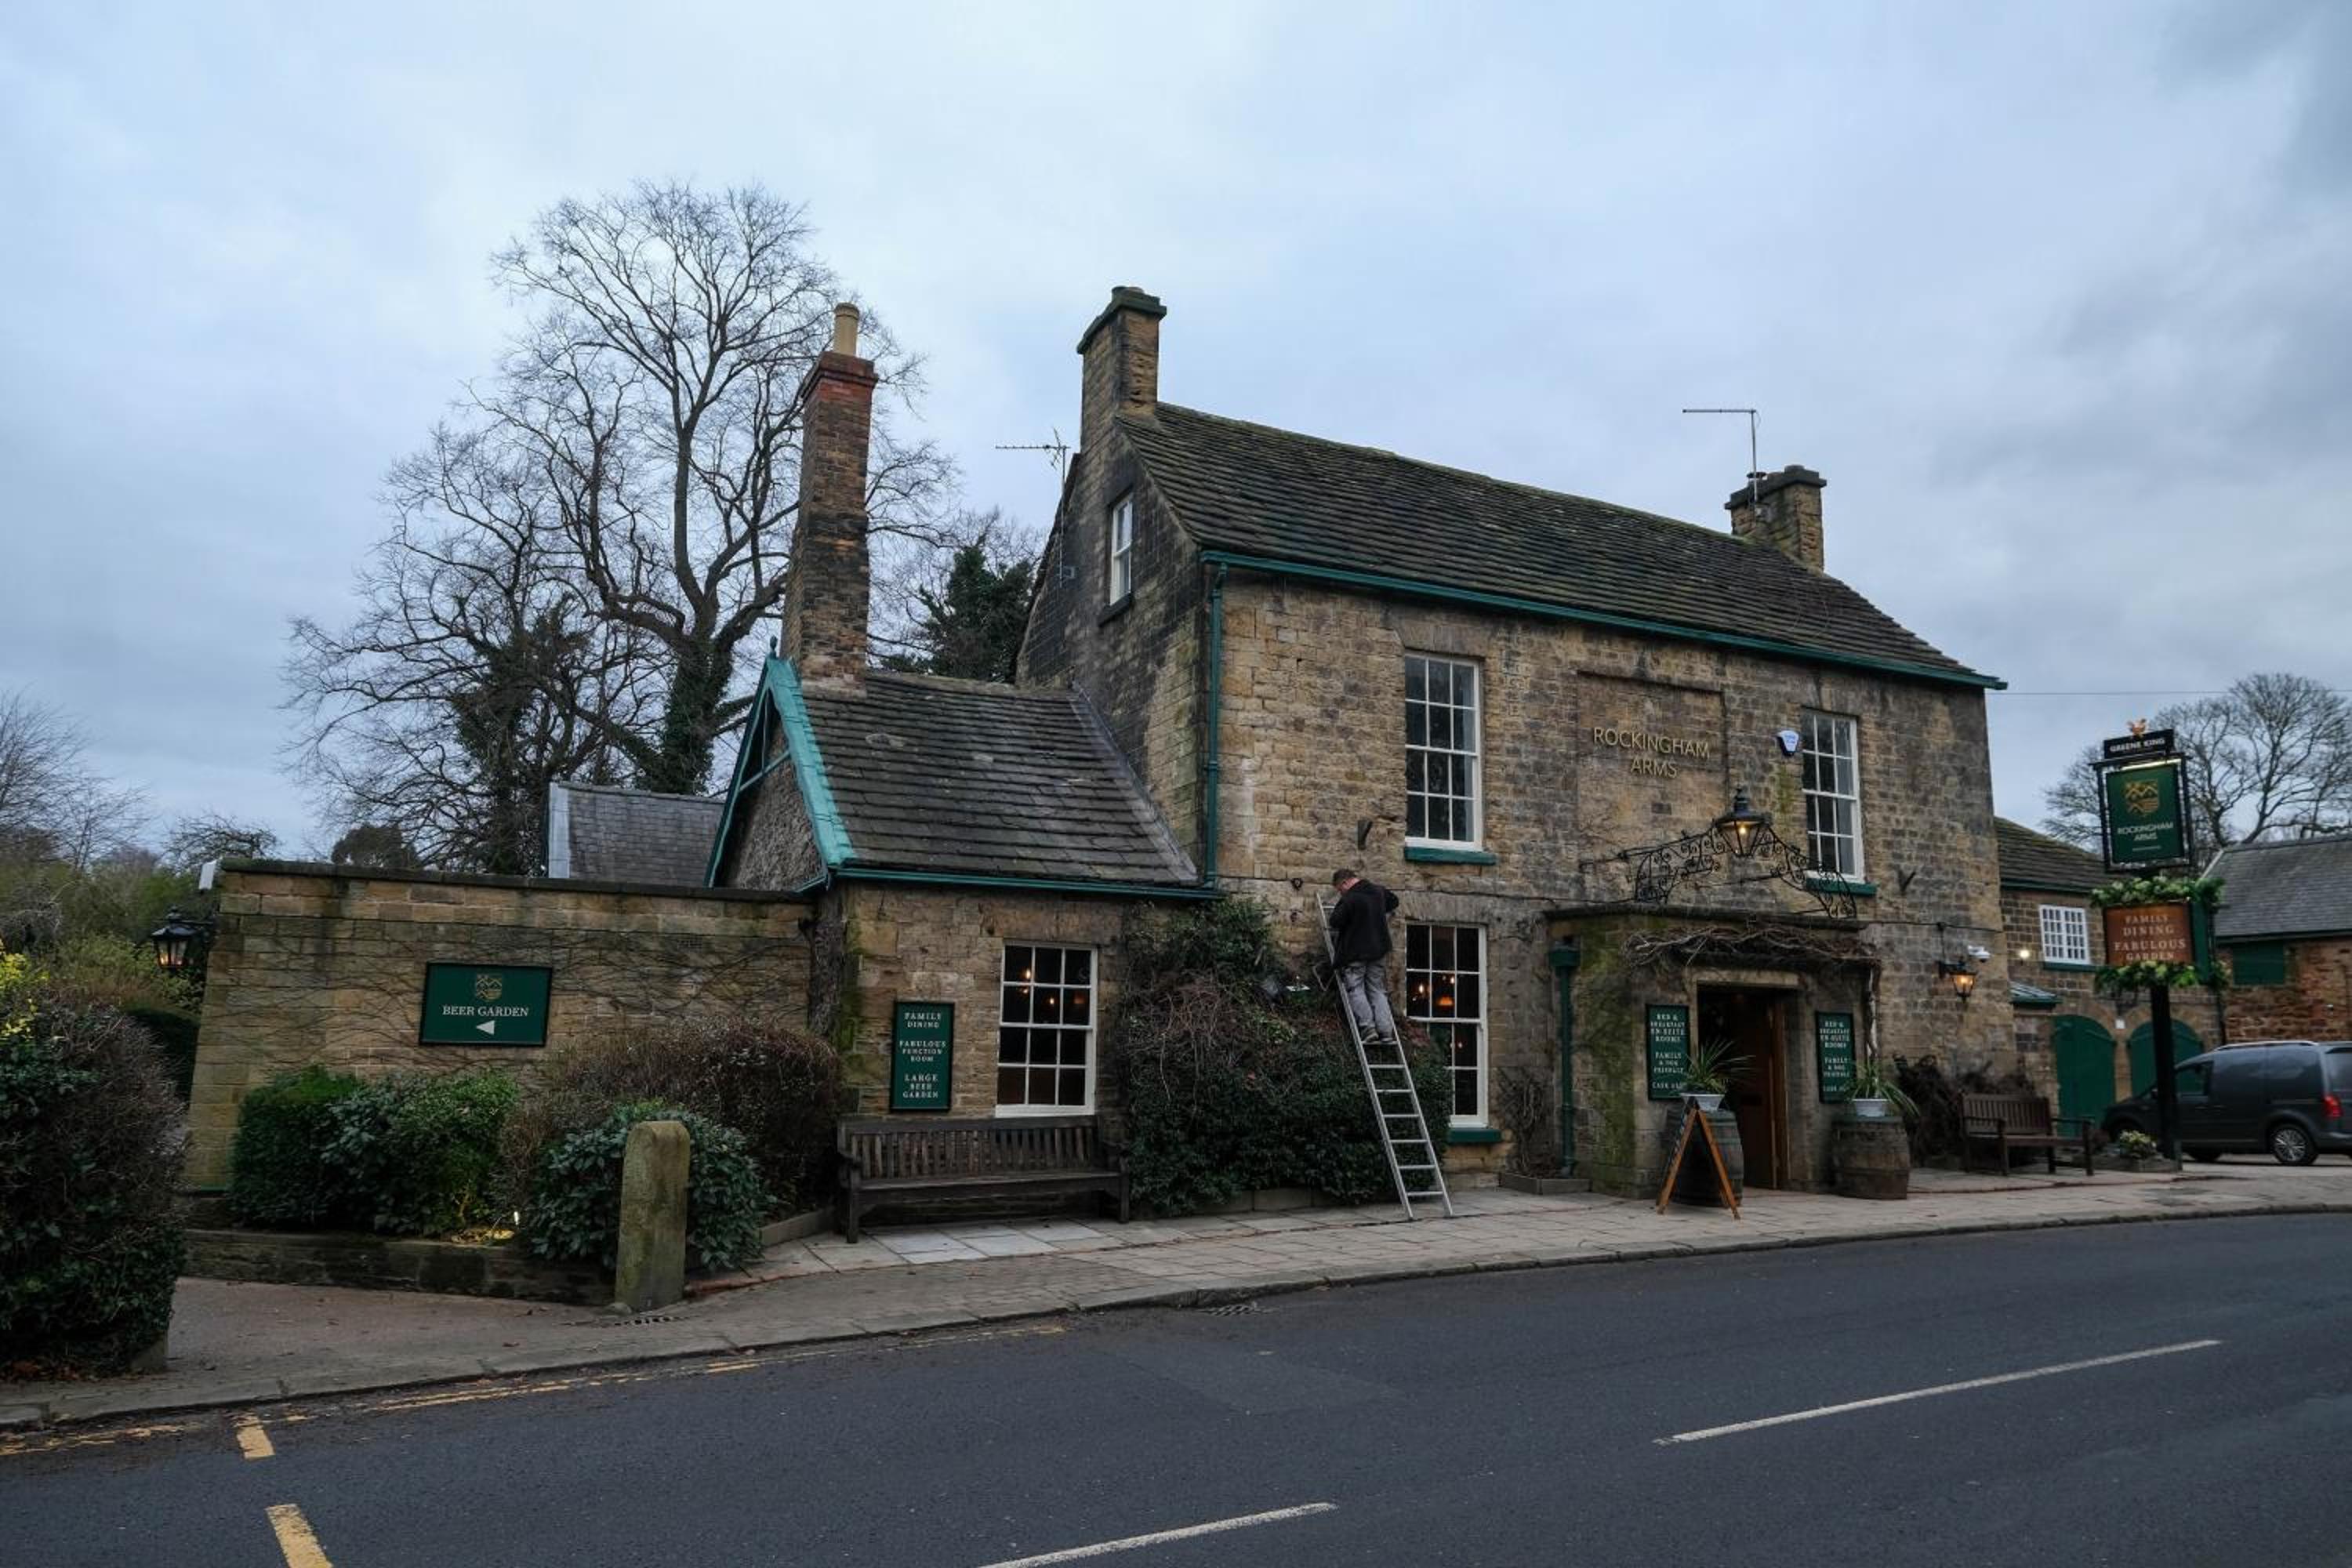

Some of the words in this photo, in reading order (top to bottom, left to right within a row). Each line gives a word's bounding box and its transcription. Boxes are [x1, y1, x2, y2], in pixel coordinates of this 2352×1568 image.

[1593, 727, 1710, 758] ROCKINGHAM
[2143, 739, 2165, 748] KING
[1631, 755, 1679, 779] ARMS
[2118, 822, 2174, 835] ROCKINGHAM
[2133, 832, 2158, 841] ARMS
[2125, 914, 2169, 924] FAMILY
[2123, 925, 2175, 937] DINING
[2114, 938, 2187, 951] FABULOUS
[2125, 951, 2175, 961] GARDEN
[442, 1005, 474, 1016] BEER
[477, 1006, 529, 1017] GARDEN
